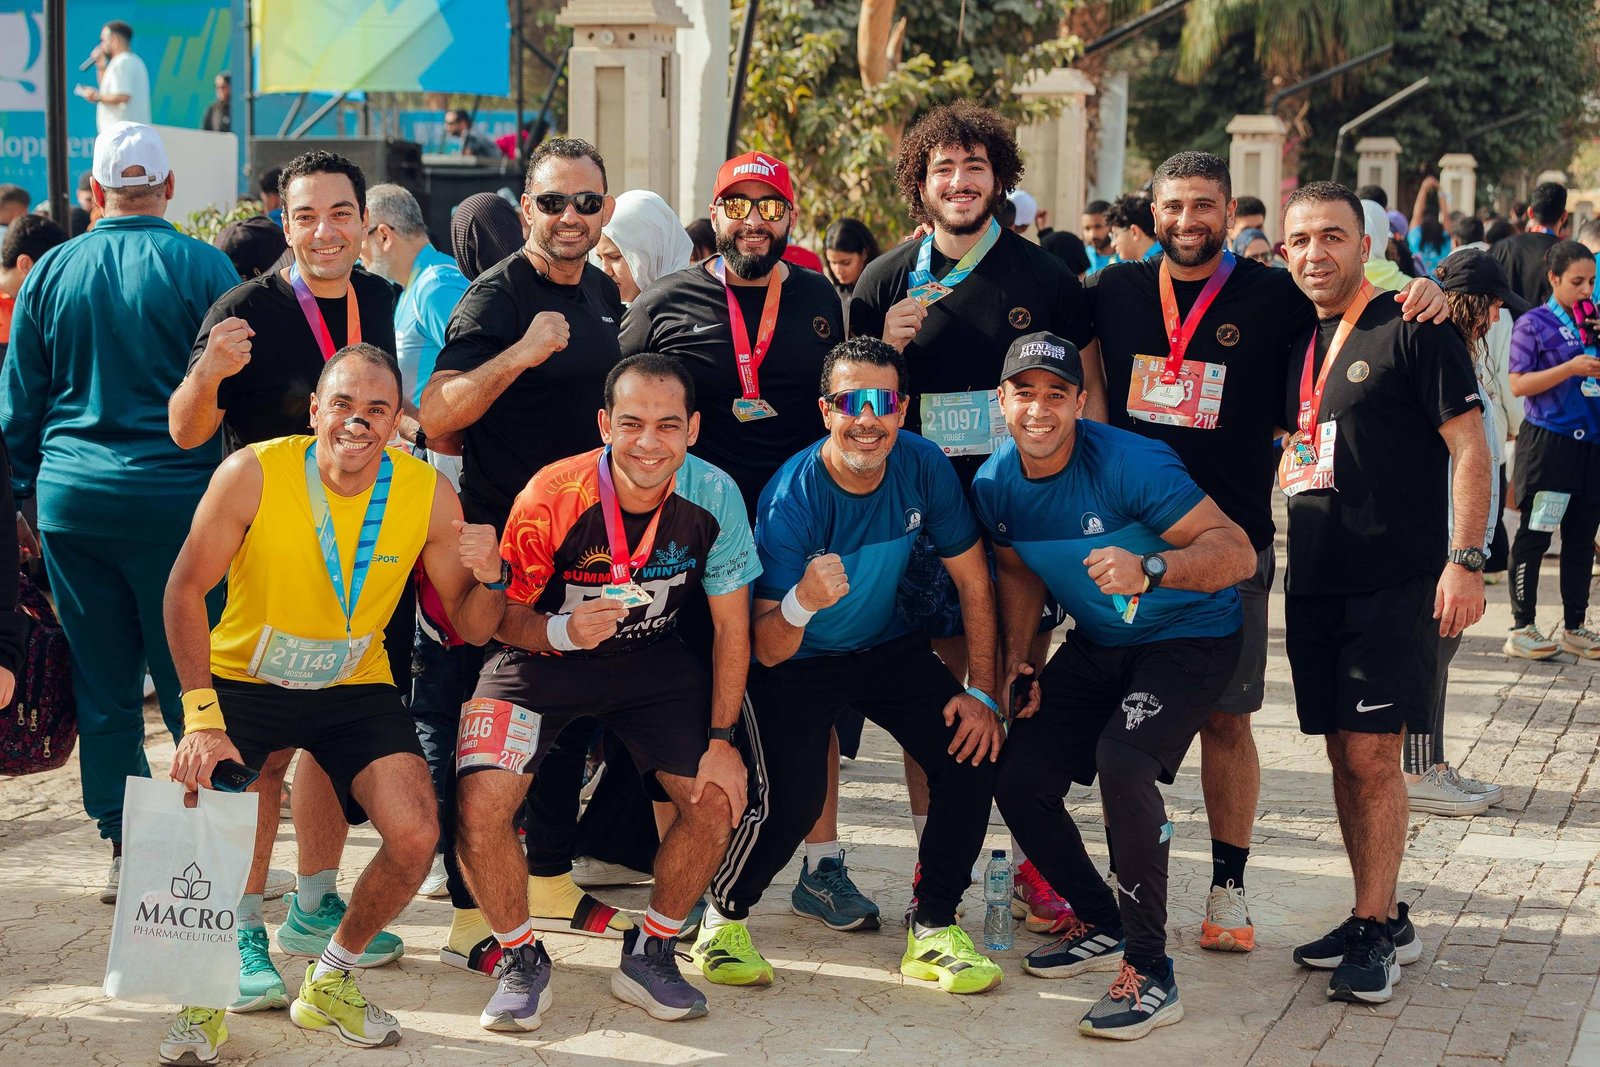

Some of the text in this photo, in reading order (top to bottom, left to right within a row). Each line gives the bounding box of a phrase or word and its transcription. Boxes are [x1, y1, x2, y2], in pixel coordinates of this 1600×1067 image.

[733, 163, 769, 176] PUMA
[1019, 350, 1065, 360] FACTORY
[1021, 341, 1065, 354] FITNESS
[926, 408, 981, 431] 21097
[1193, 412, 1219, 429] 21K
[942, 432, 966, 442] YOUSEF
[988, 436, 1006, 454] 10
[1311, 472, 1333, 488] 21K
[563, 570, 611, 583] SUMM
[642, 558, 697, 578] WINTER
[270, 647, 337, 670] 21143
[283, 668, 314, 679] HOSSAM
[460, 716, 493, 740] 446
[136, 901, 234, 931] MACRO
[133, 924, 234, 943] PHARMACEUTICALS
